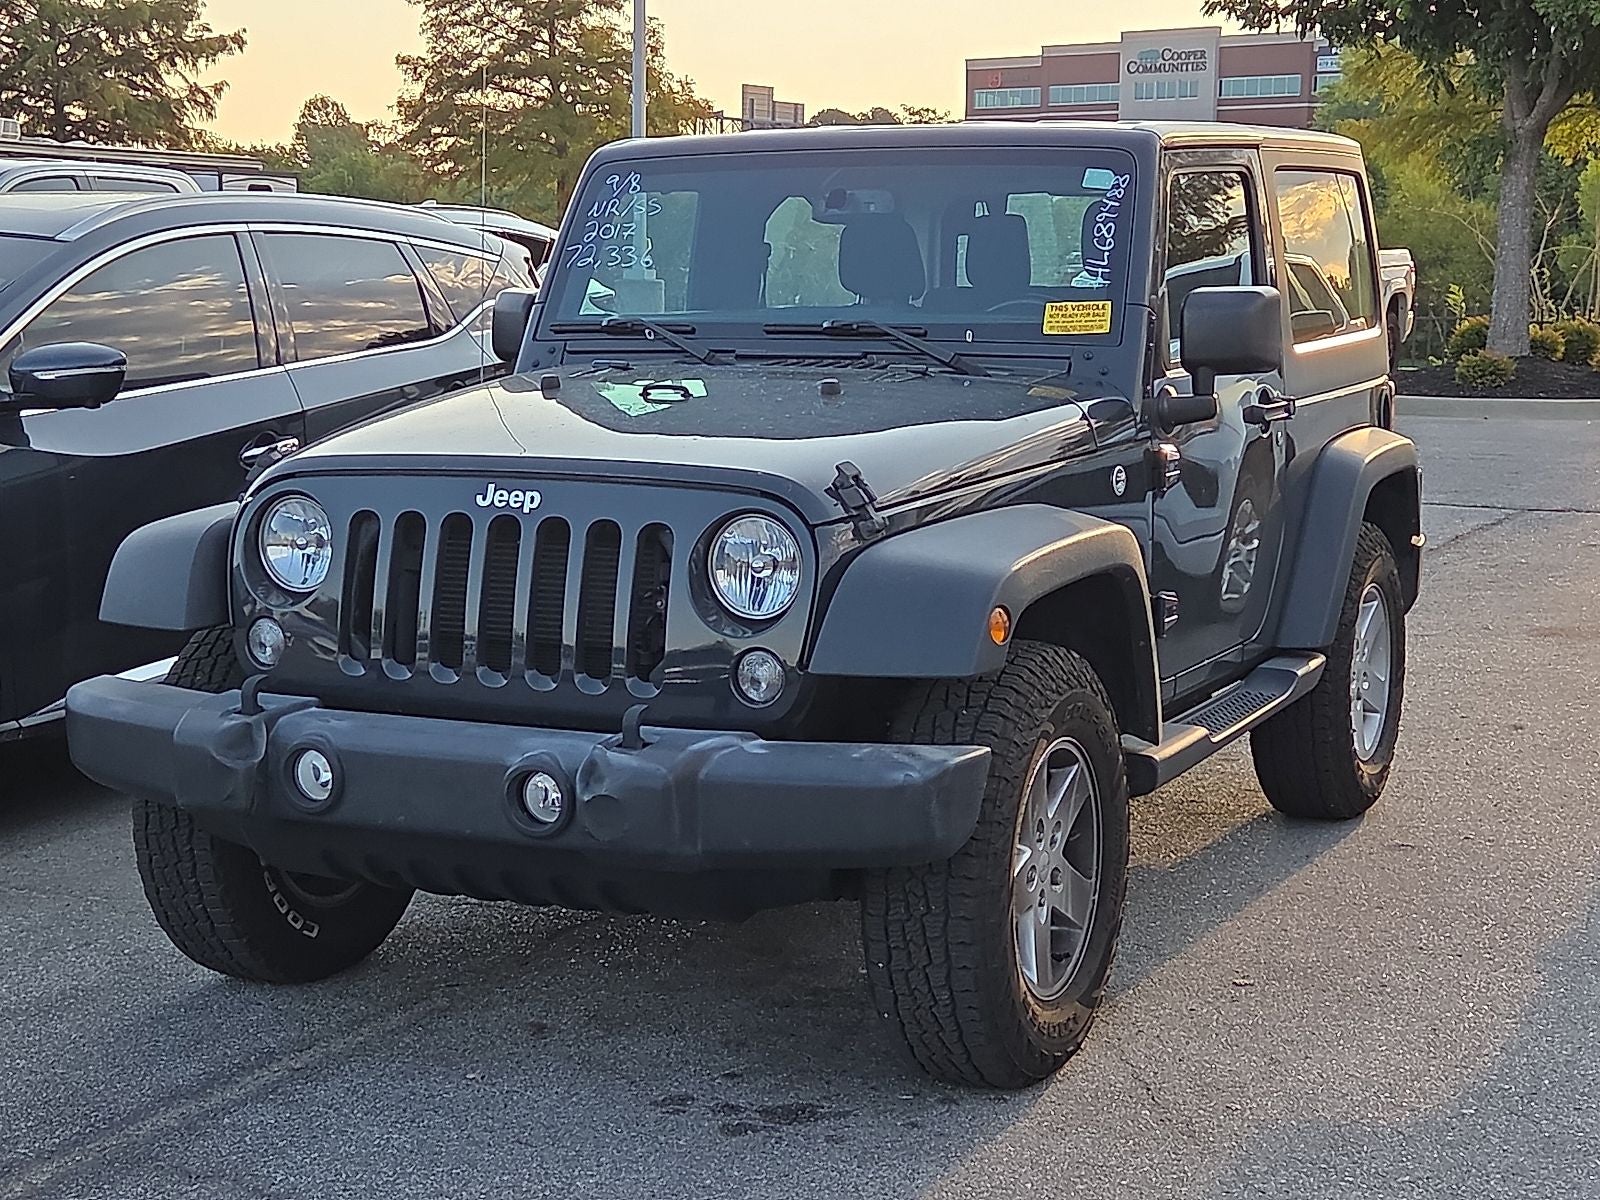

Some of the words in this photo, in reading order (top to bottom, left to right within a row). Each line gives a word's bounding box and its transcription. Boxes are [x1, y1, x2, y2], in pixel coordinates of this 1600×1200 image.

[606, 171, 641, 197] 9/8
[584, 220, 637, 243] 2017
[566, 243, 653, 269] 72,336
[1050, 304, 1069, 312] THIS
[1070, 303, 1107, 312] VEHICLE
[475, 482, 541, 514] Jeep
